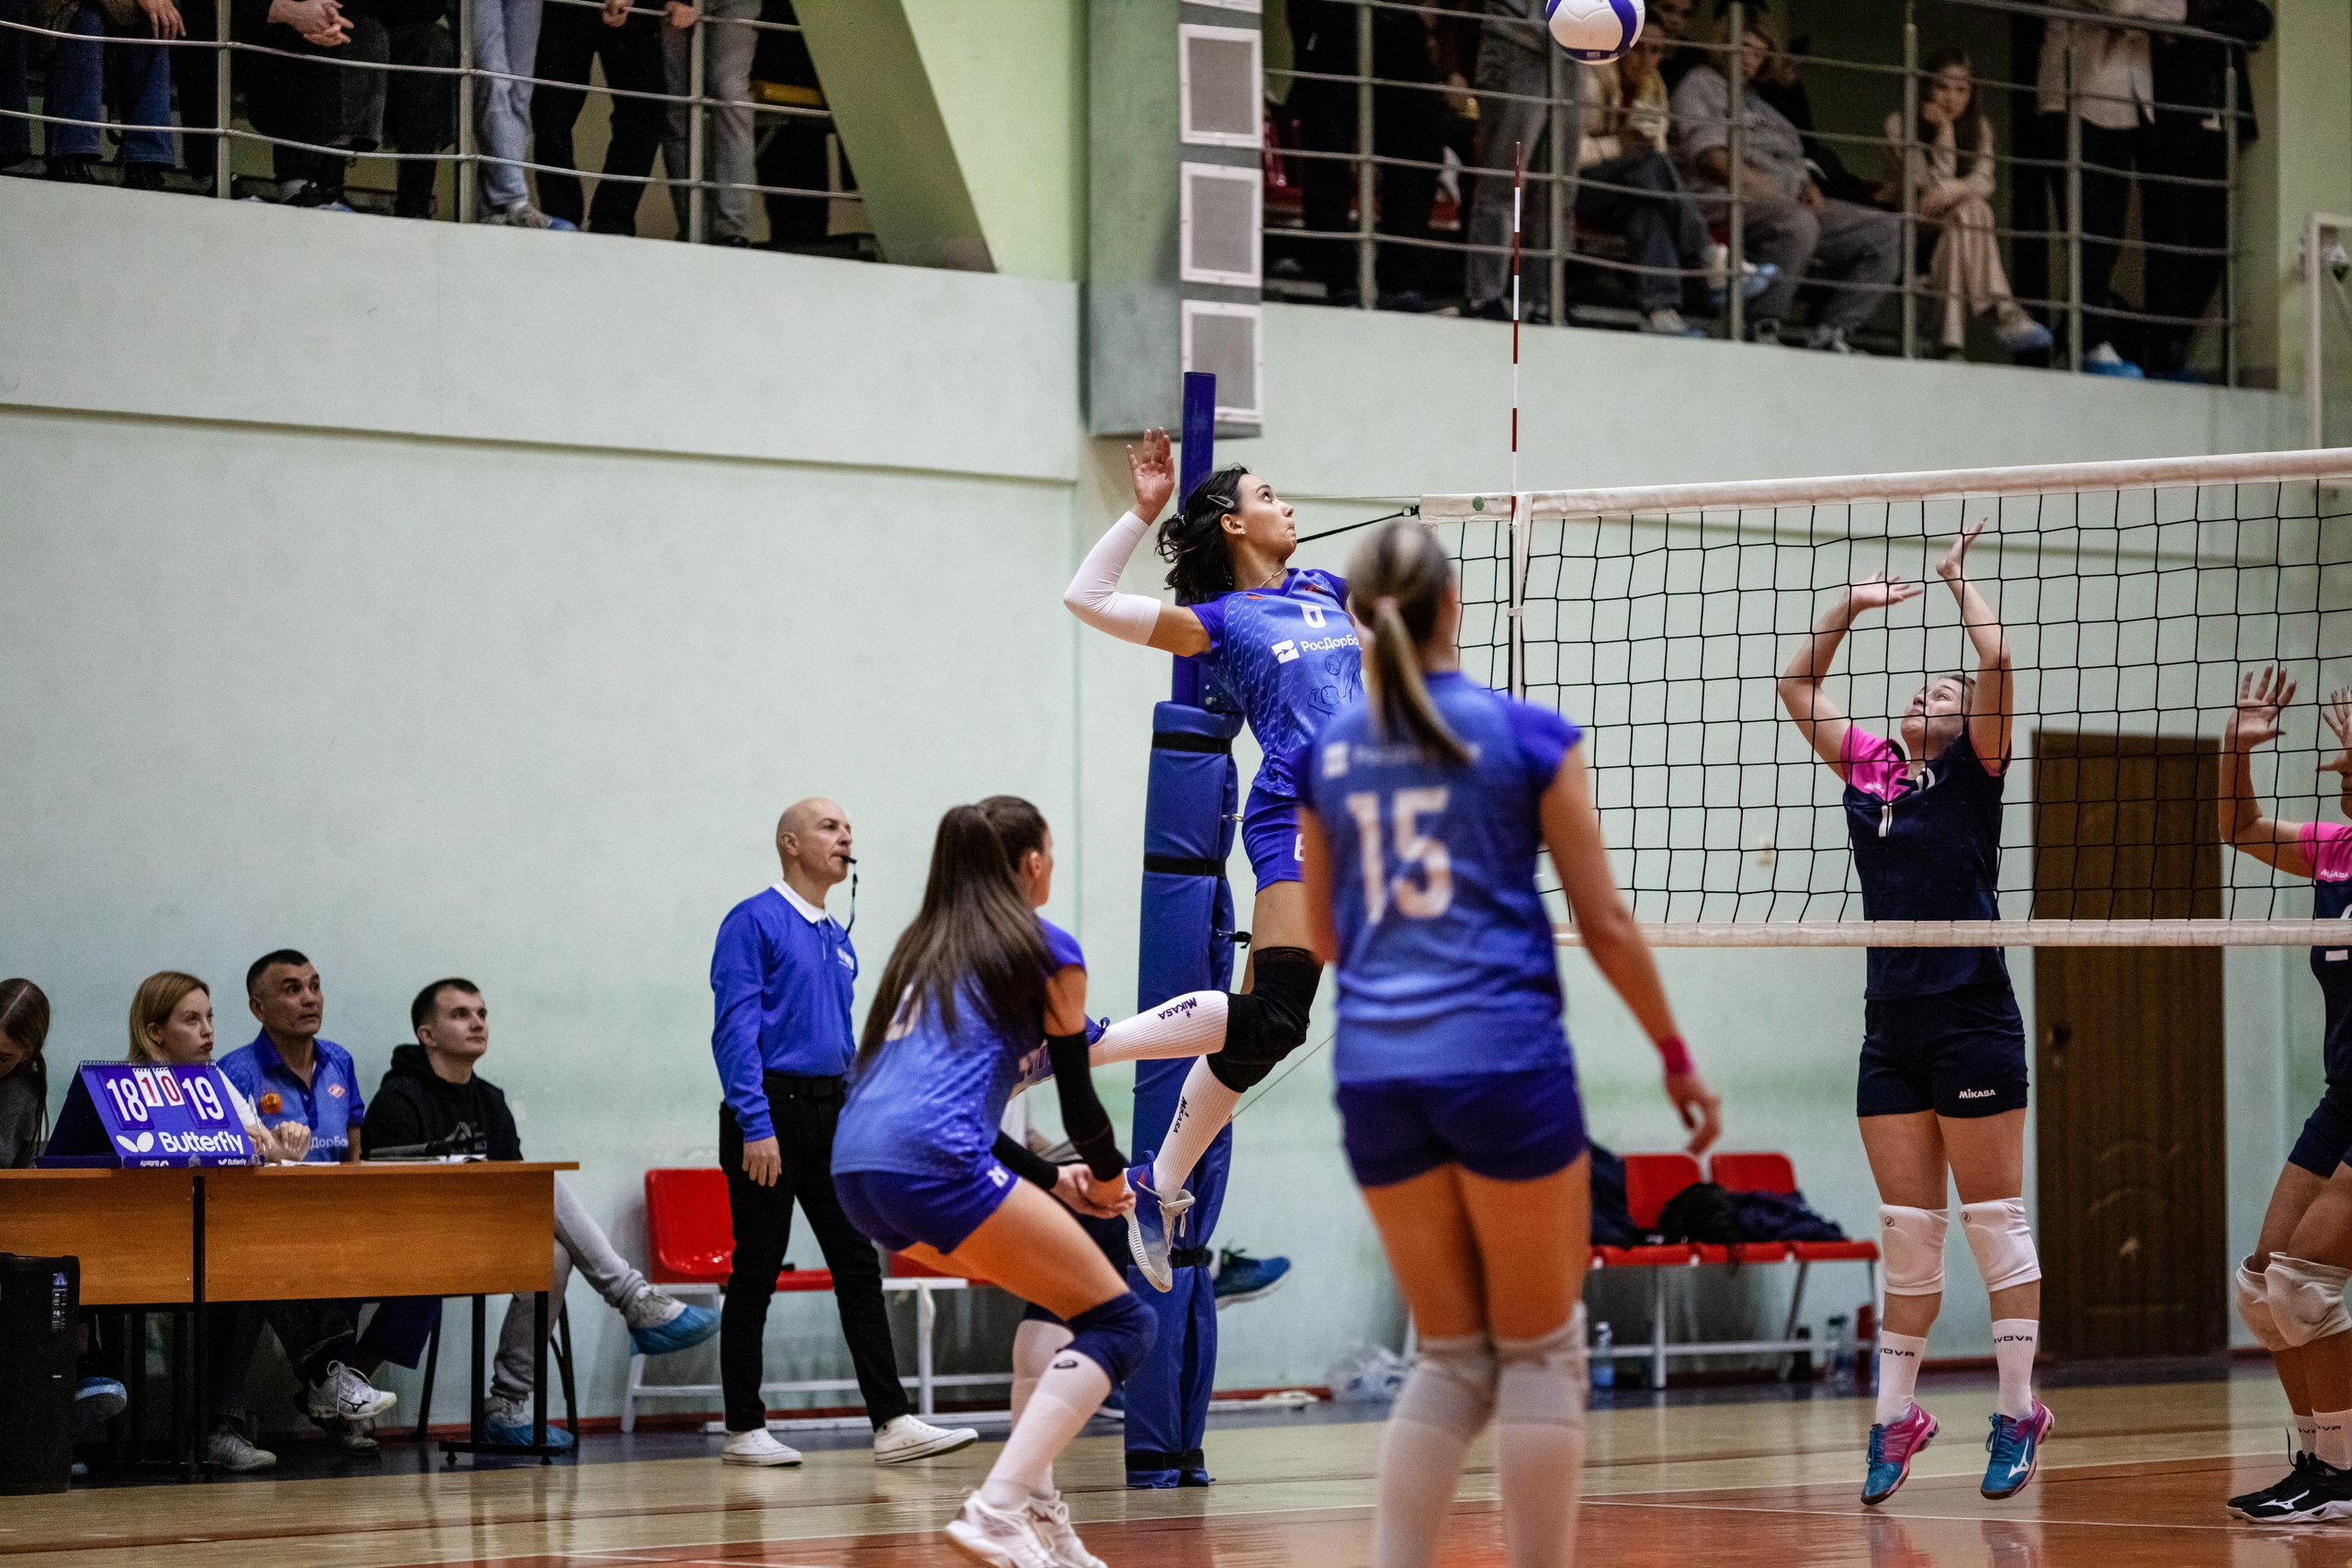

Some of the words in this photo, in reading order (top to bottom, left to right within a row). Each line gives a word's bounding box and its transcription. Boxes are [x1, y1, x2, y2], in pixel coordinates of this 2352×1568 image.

[1346, 785, 1453, 924] 15
[106, 1078, 148, 1122] 18
[141, 1077, 157, 1103] 1
[161, 1075, 181, 1103] 0
[182, 1076, 224, 1121] 19
[158, 1131, 244, 1155] Butterfly
